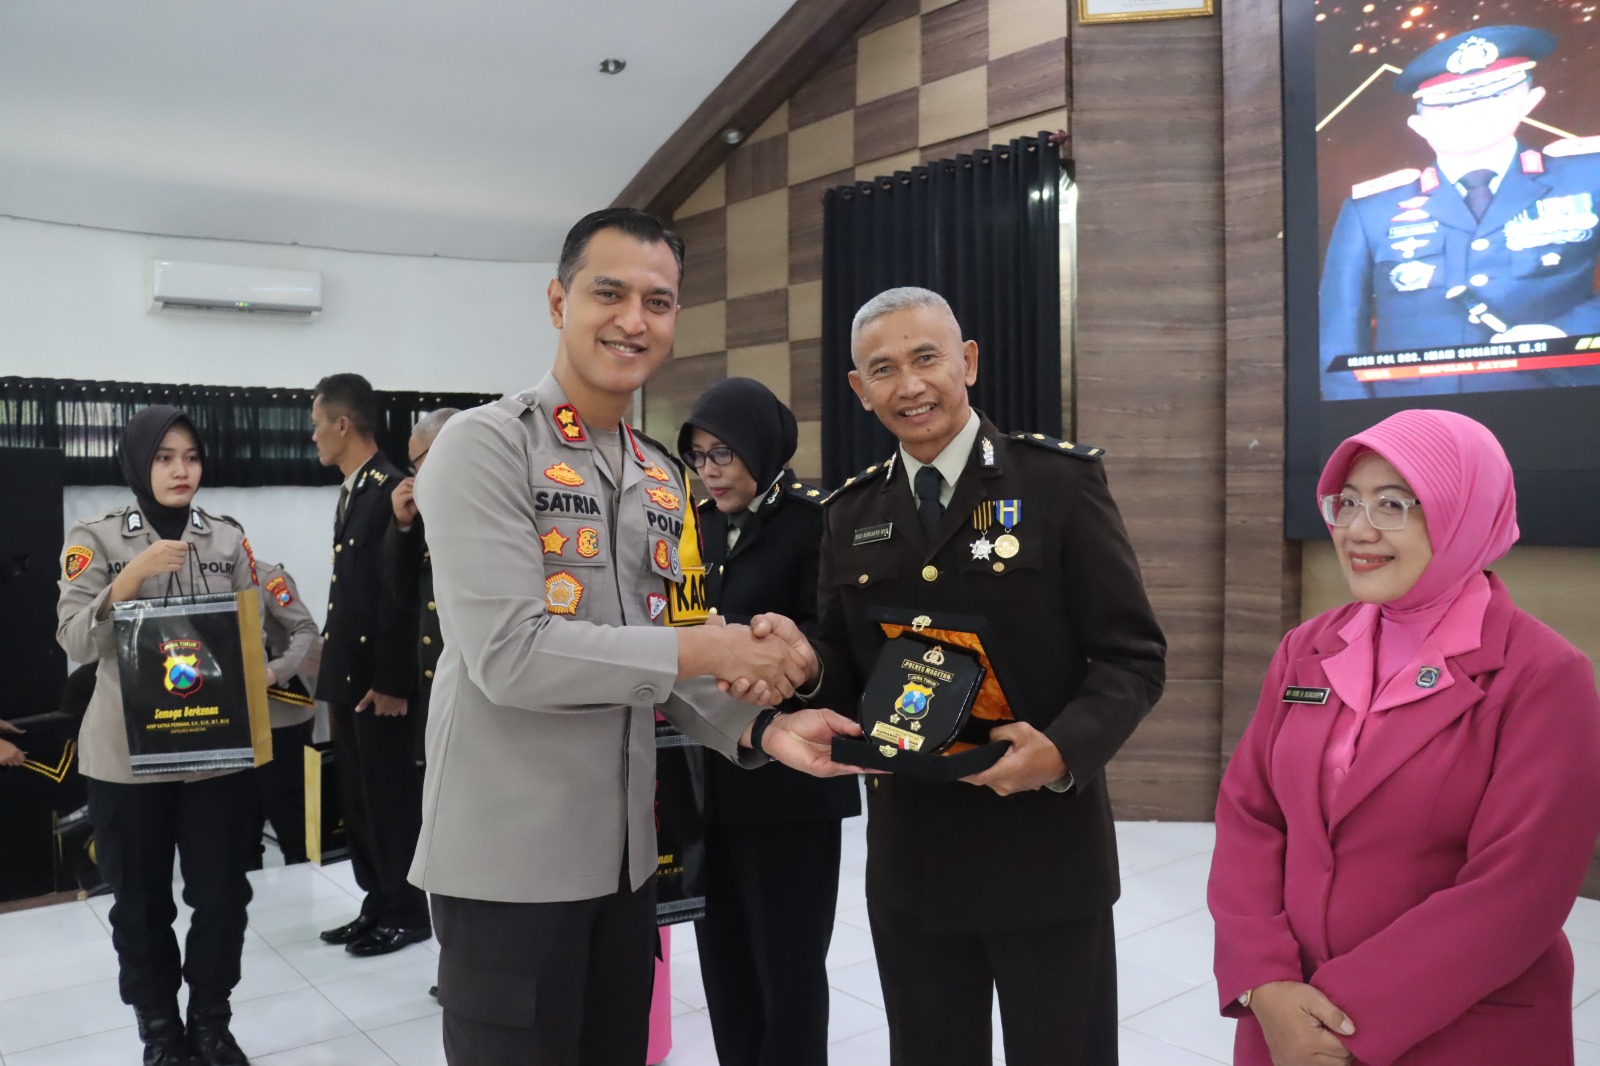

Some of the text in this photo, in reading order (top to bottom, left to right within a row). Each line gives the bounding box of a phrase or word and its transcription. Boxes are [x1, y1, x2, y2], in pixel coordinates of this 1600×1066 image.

[1376, 354, 1395, 365] POL
[535, 491, 601, 515] SATRIA
[904, 661, 952, 680] POLRES MAGETAN
[154, 705, 219, 721] Semoga Berkenan
